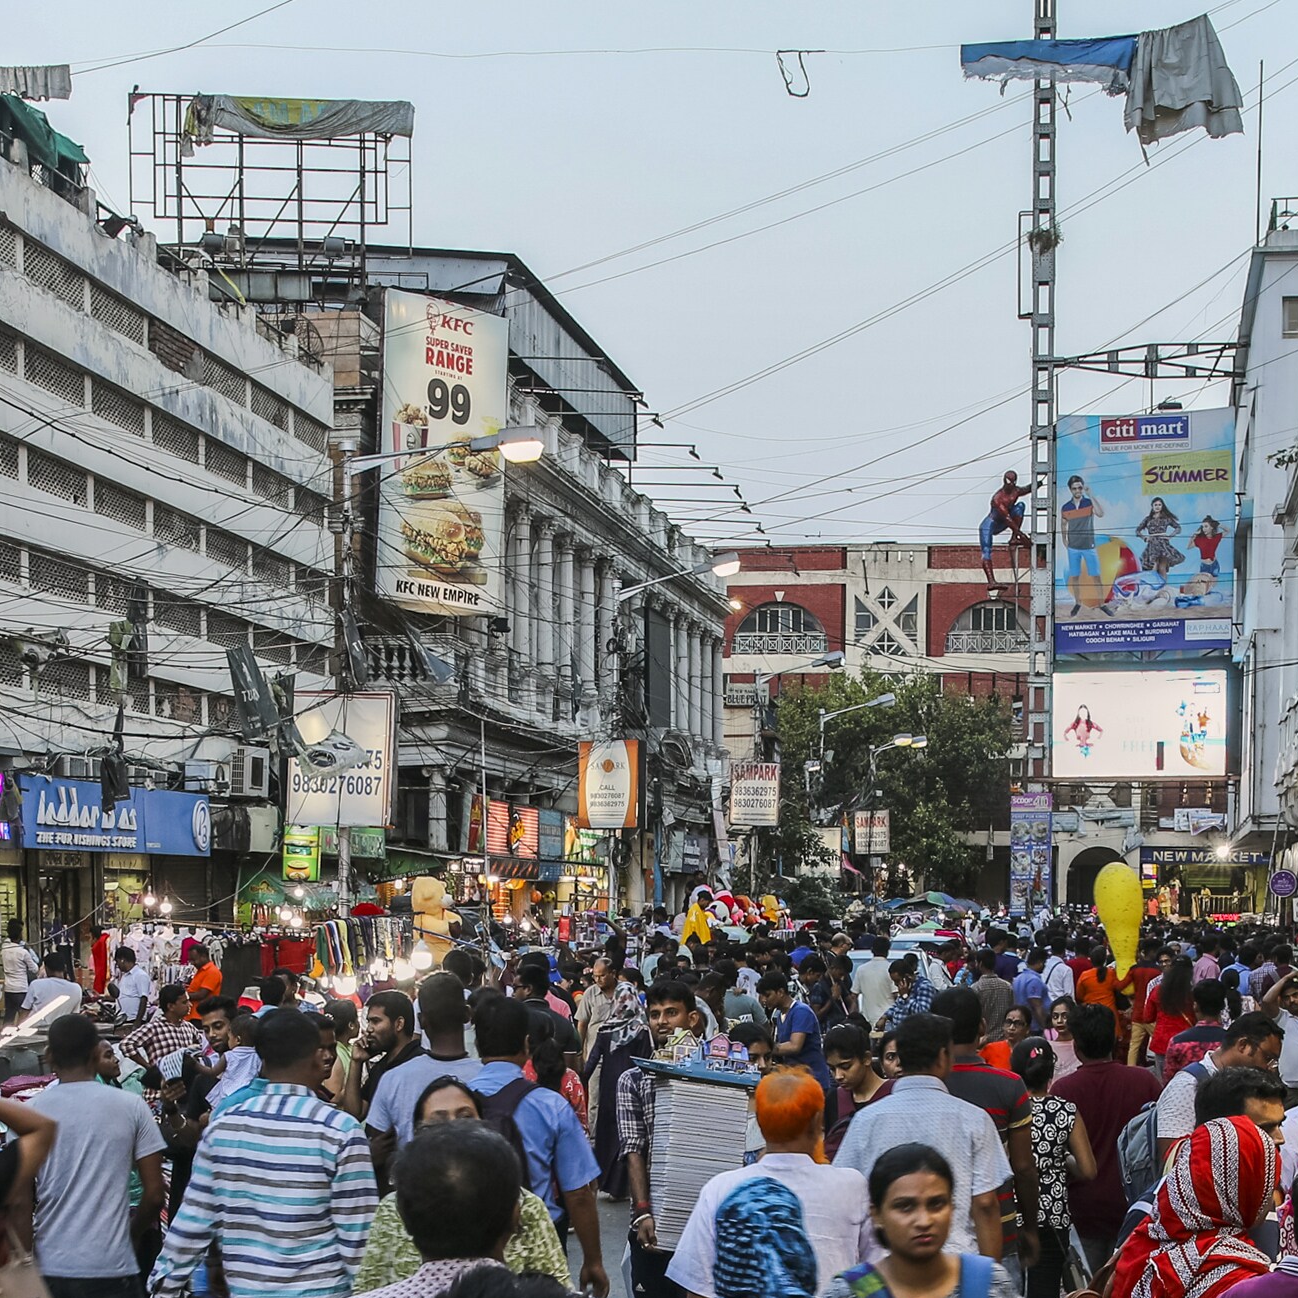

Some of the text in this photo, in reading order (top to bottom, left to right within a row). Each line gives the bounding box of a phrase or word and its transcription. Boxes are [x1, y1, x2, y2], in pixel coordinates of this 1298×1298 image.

[441, 314, 474, 335] KFC
[426, 336, 473, 357] SUPER SAVER
[426, 347, 473, 375] RANGE
[1106, 420, 1184, 438] citi mart
[1145, 467, 1229, 483] SUMMER
[396, 580, 480, 606] KFC NEW EMPIRE
[733, 764, 777, 781] SAMPARK
[293, 776, 382, 796] 9830276087
[734, 786, 777, 797] 9836362975
[733, 799, 777, 809] 9830276087
[34, 831, 52, 844] THE
[109, 835, 136, 848] STORE
[1153, 851, 1187, 862] NEW
